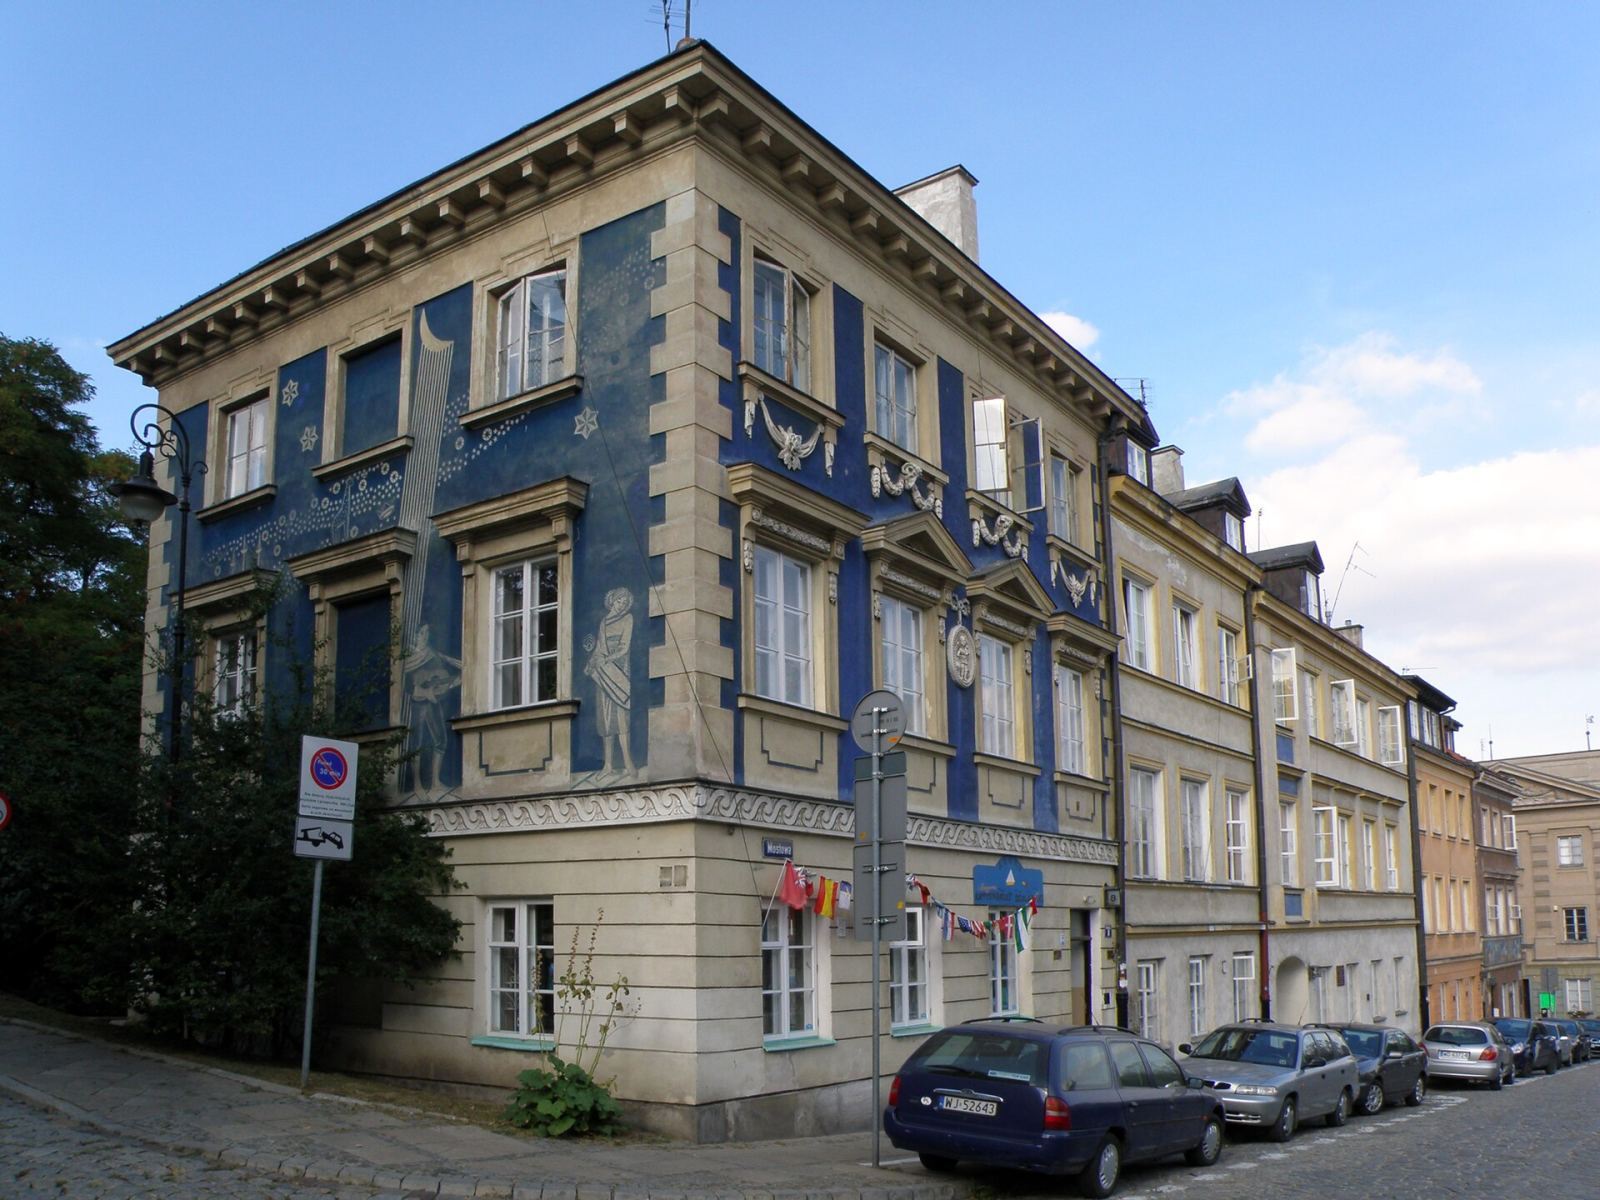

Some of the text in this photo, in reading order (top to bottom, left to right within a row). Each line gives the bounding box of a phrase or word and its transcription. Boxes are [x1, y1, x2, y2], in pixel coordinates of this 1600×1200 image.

[767, 842, 791, 854] Mostowa
[945, 1096, 995, 1114] WJ 52643
